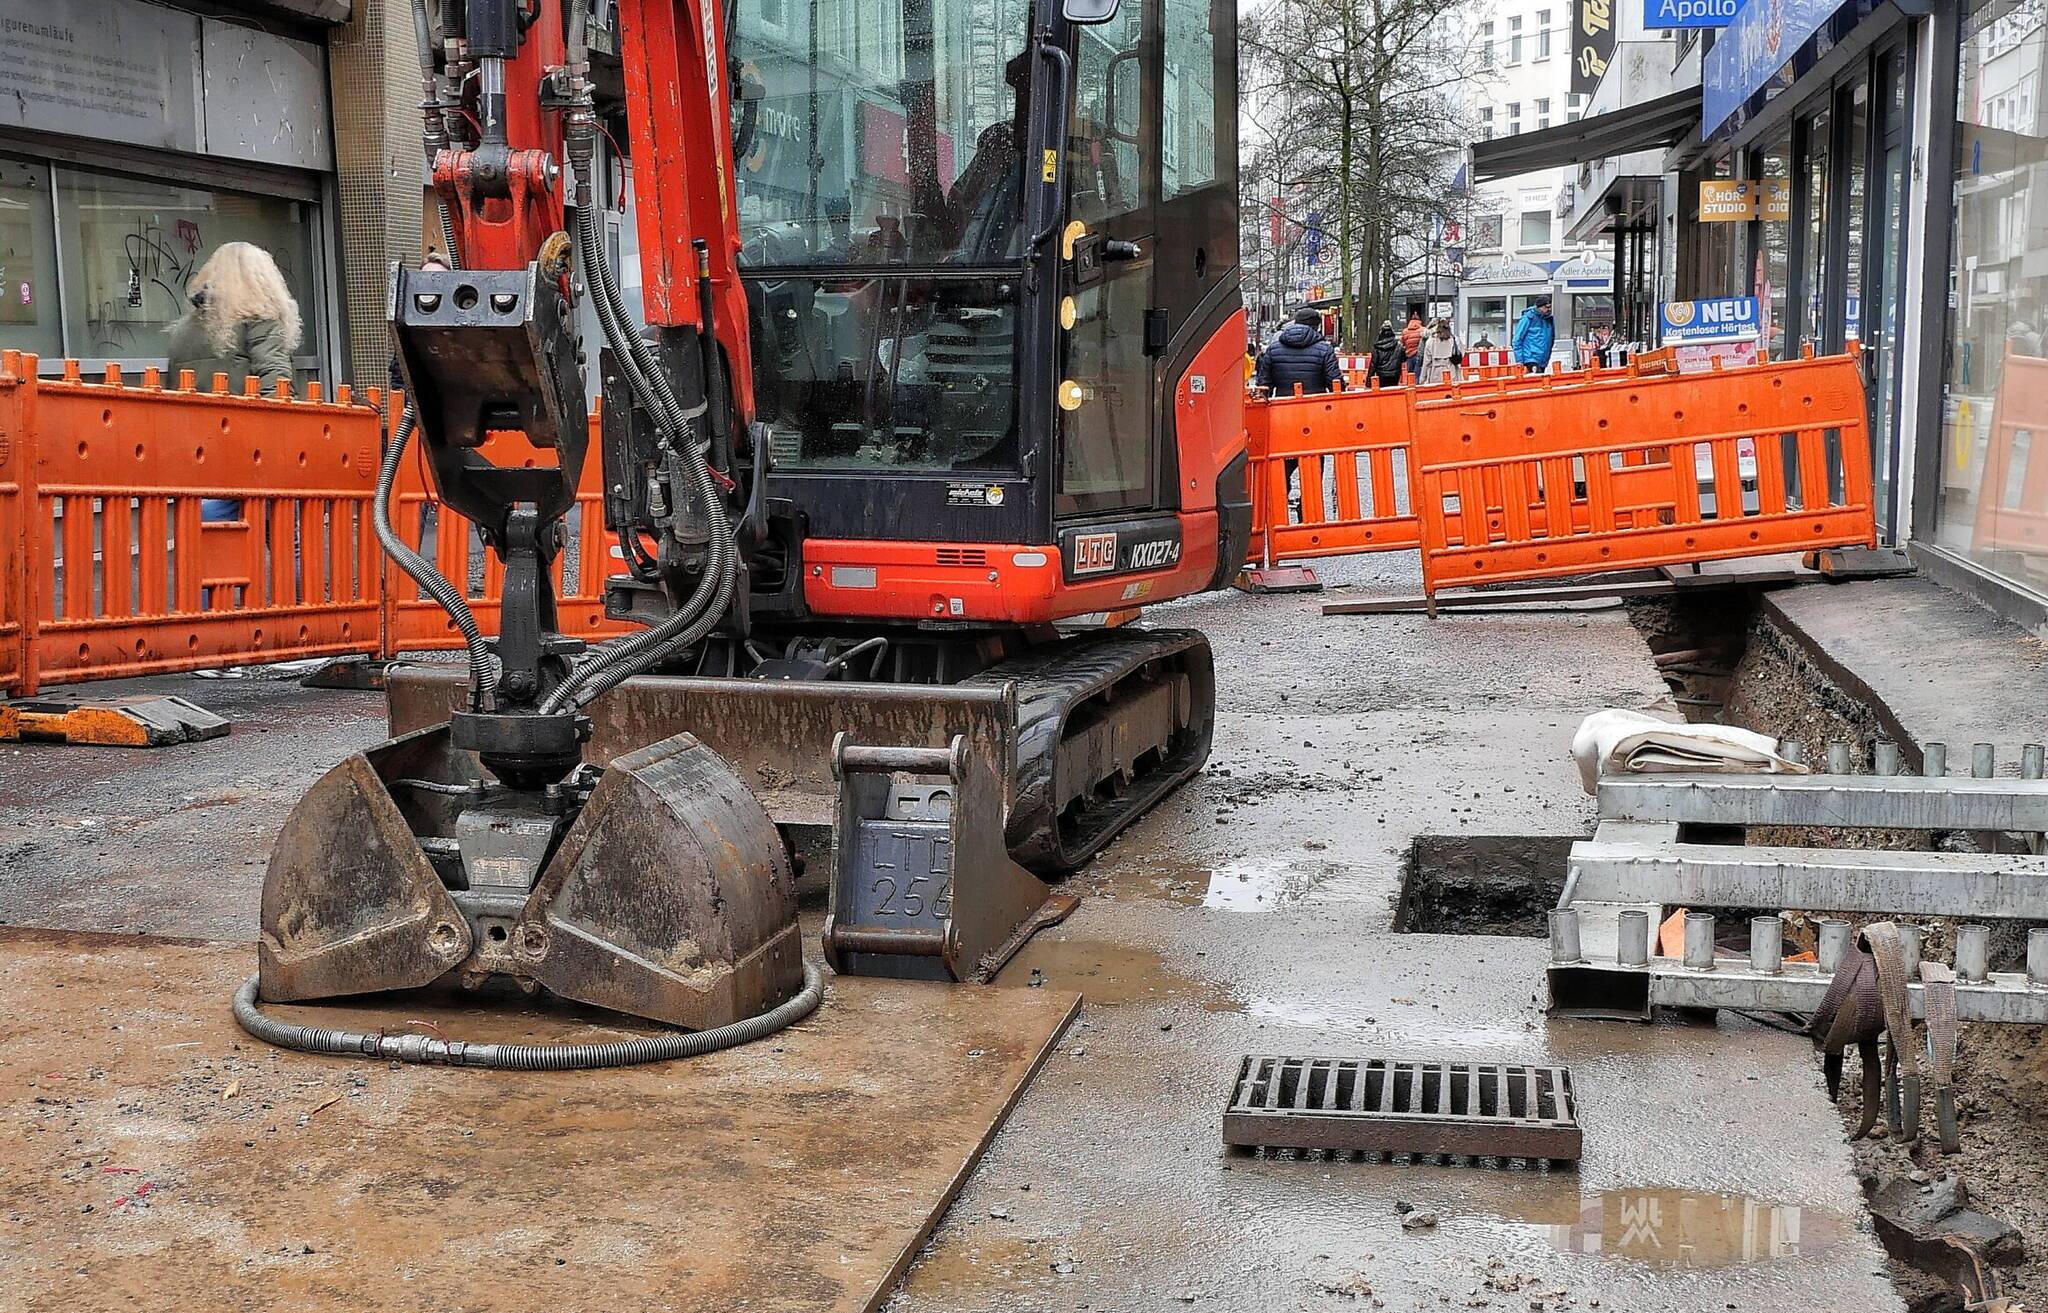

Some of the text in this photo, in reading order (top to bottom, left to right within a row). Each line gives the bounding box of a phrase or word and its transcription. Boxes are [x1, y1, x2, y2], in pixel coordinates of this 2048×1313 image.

[1658, 0, 1737, 23] Apollo
[1715, 189, 1745, 202] HÖR-
[1703, 203, 1747, 214] STUDIO
[1561, 266, 1580, 276] Adler
[1701, 299, 1752, 324] NEU
[1665, 322, 1756, 337] Kostenloser Hörtest
[1077, 540, 1113, 564] LTG
